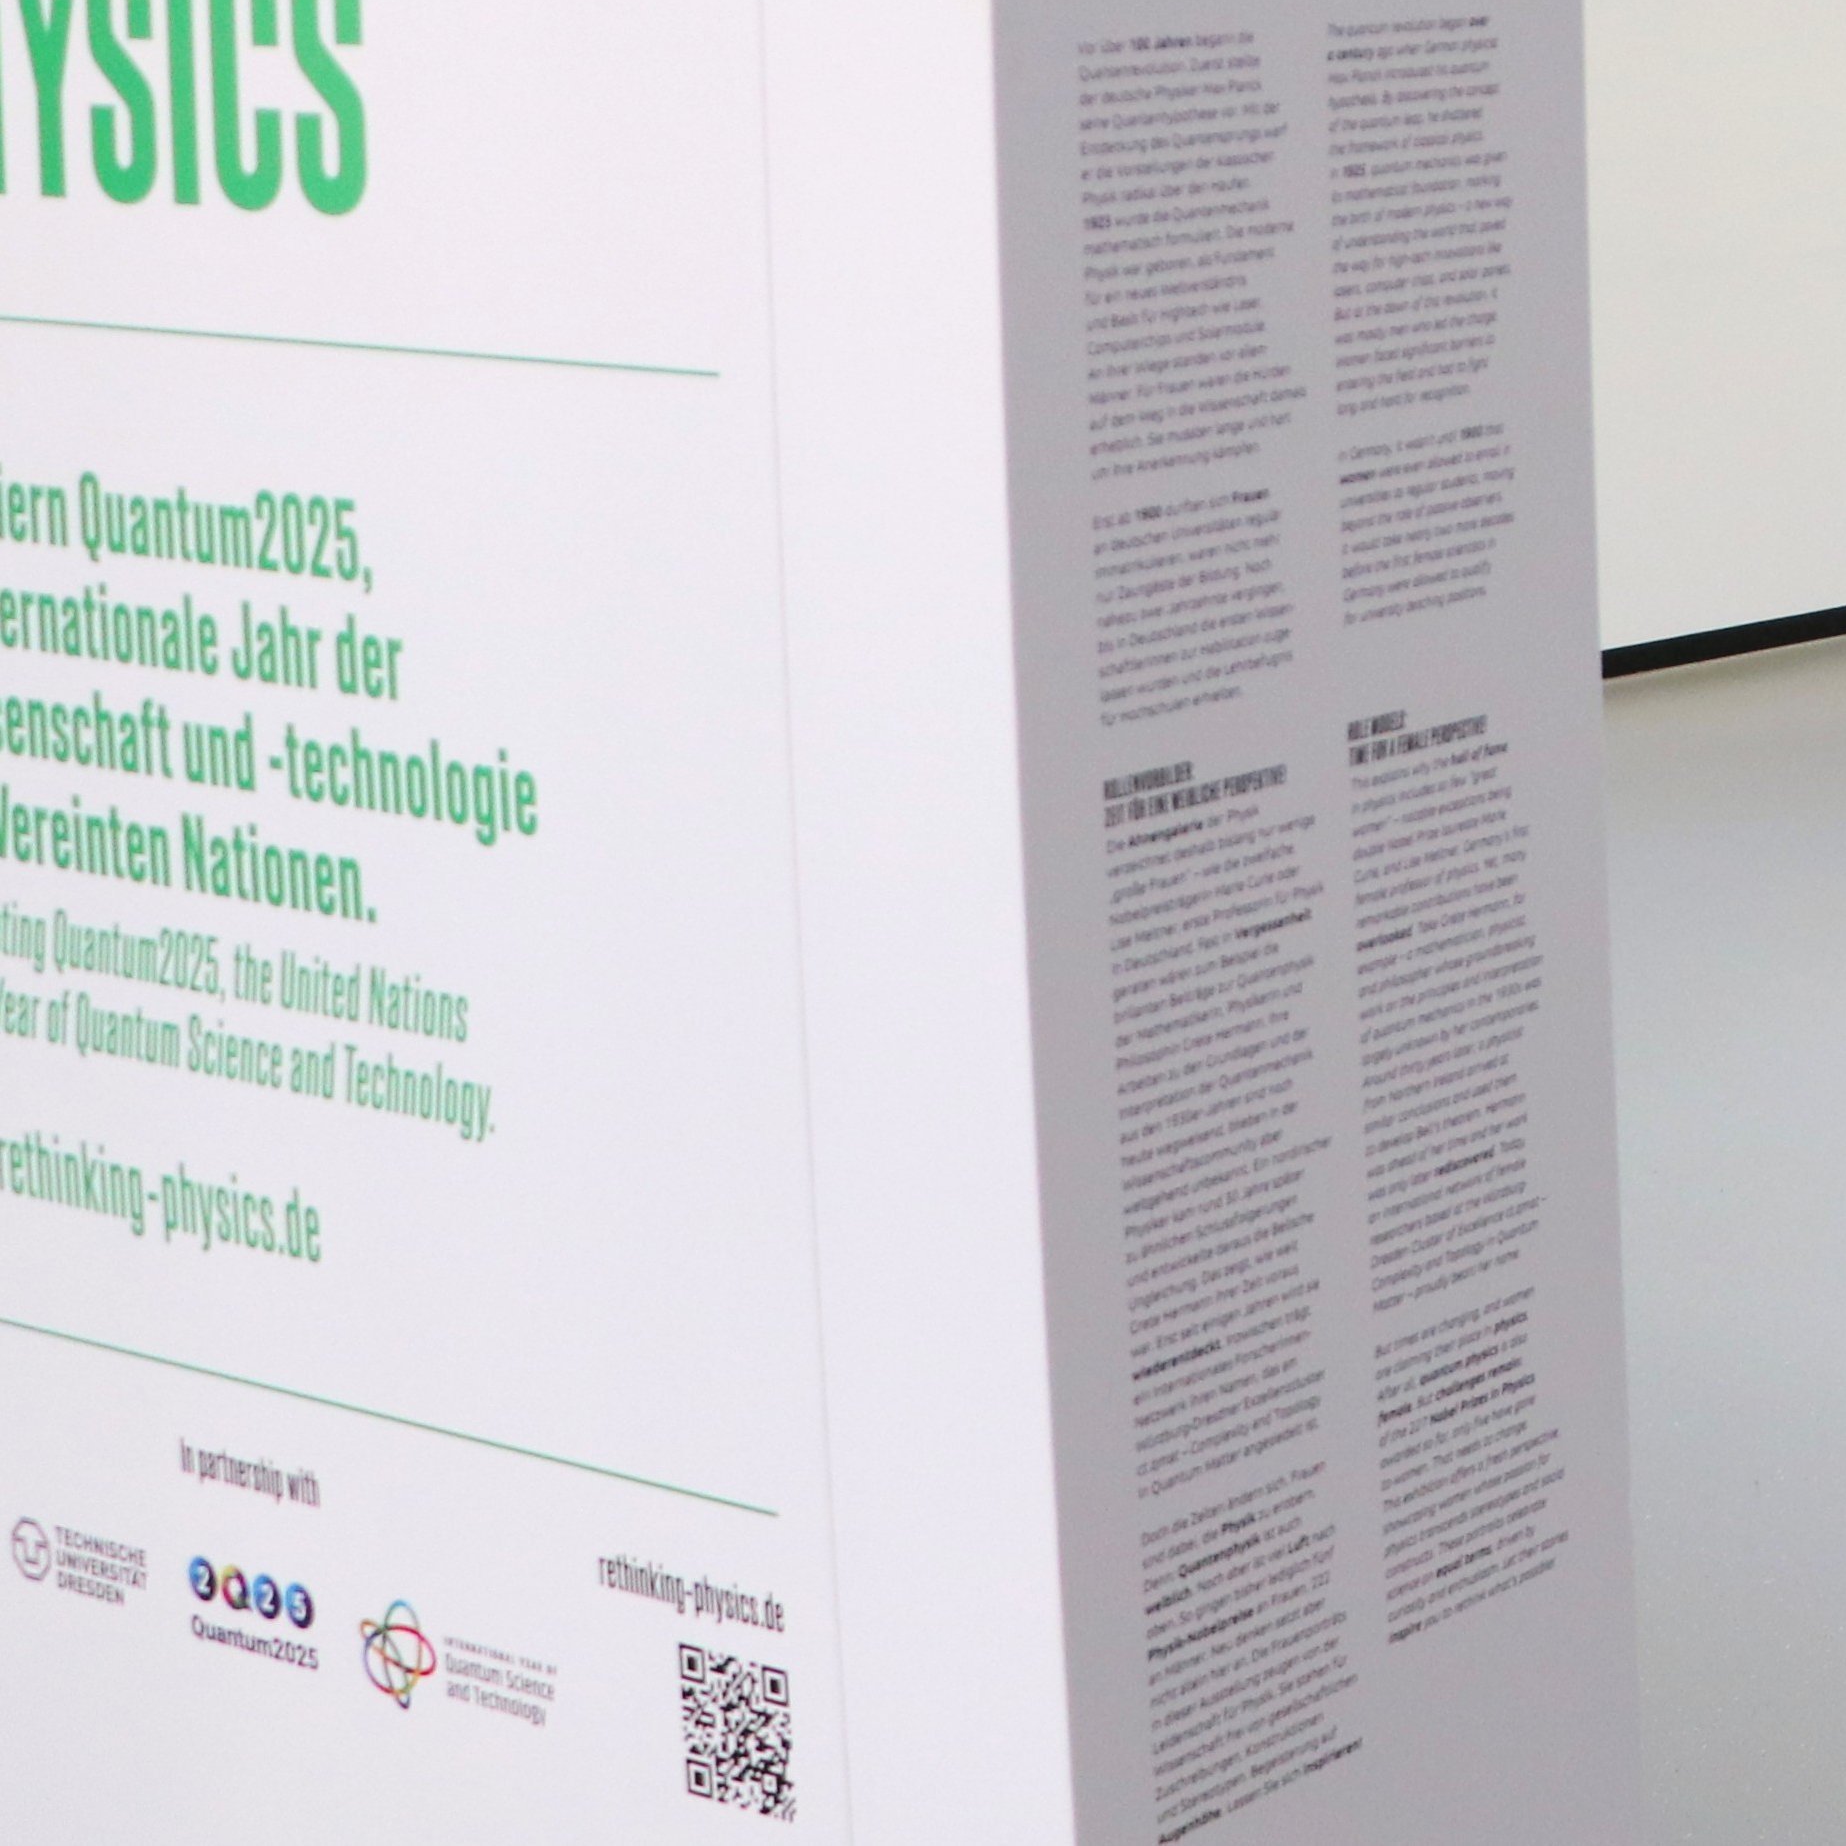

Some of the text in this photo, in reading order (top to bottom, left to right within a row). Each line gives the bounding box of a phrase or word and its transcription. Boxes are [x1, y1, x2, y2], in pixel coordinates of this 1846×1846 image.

[79, 472, 373, 594] Quantum2025,
[232, 601, 321, 689] Jahr
[335, 615, 403, 701] der
[184, 713, 255, 792] und
[271, 725, 539, 847] -technologie
[181, 813, 378, 924] Nationen.
[54, 908, 226, 1005] Quantum2025,
[233, 942, 273, 1009] the
[281, 951, 361, 1023] United
[370, 965, 469, 1044] Nations
[48, 989, 73, 1045] of
[75, 993, 181, 1069] Quantum
[188, 1014, 283, 1091] Science
[290, 1040, 335, 1100] and
[345, 1044, 497, 1142] Technology.
[199, 1450, 283, 1504] partnership
[285, 1468, 321, 1508] with
[55, 1526, 147, 1567] TECHNISCHE
[57, 1571, 125, 1606] DRESDEN
[598, 1555, 785, 1634] rethinking-physics.de
[191, 1615, 320, 1671] Quantum2025
